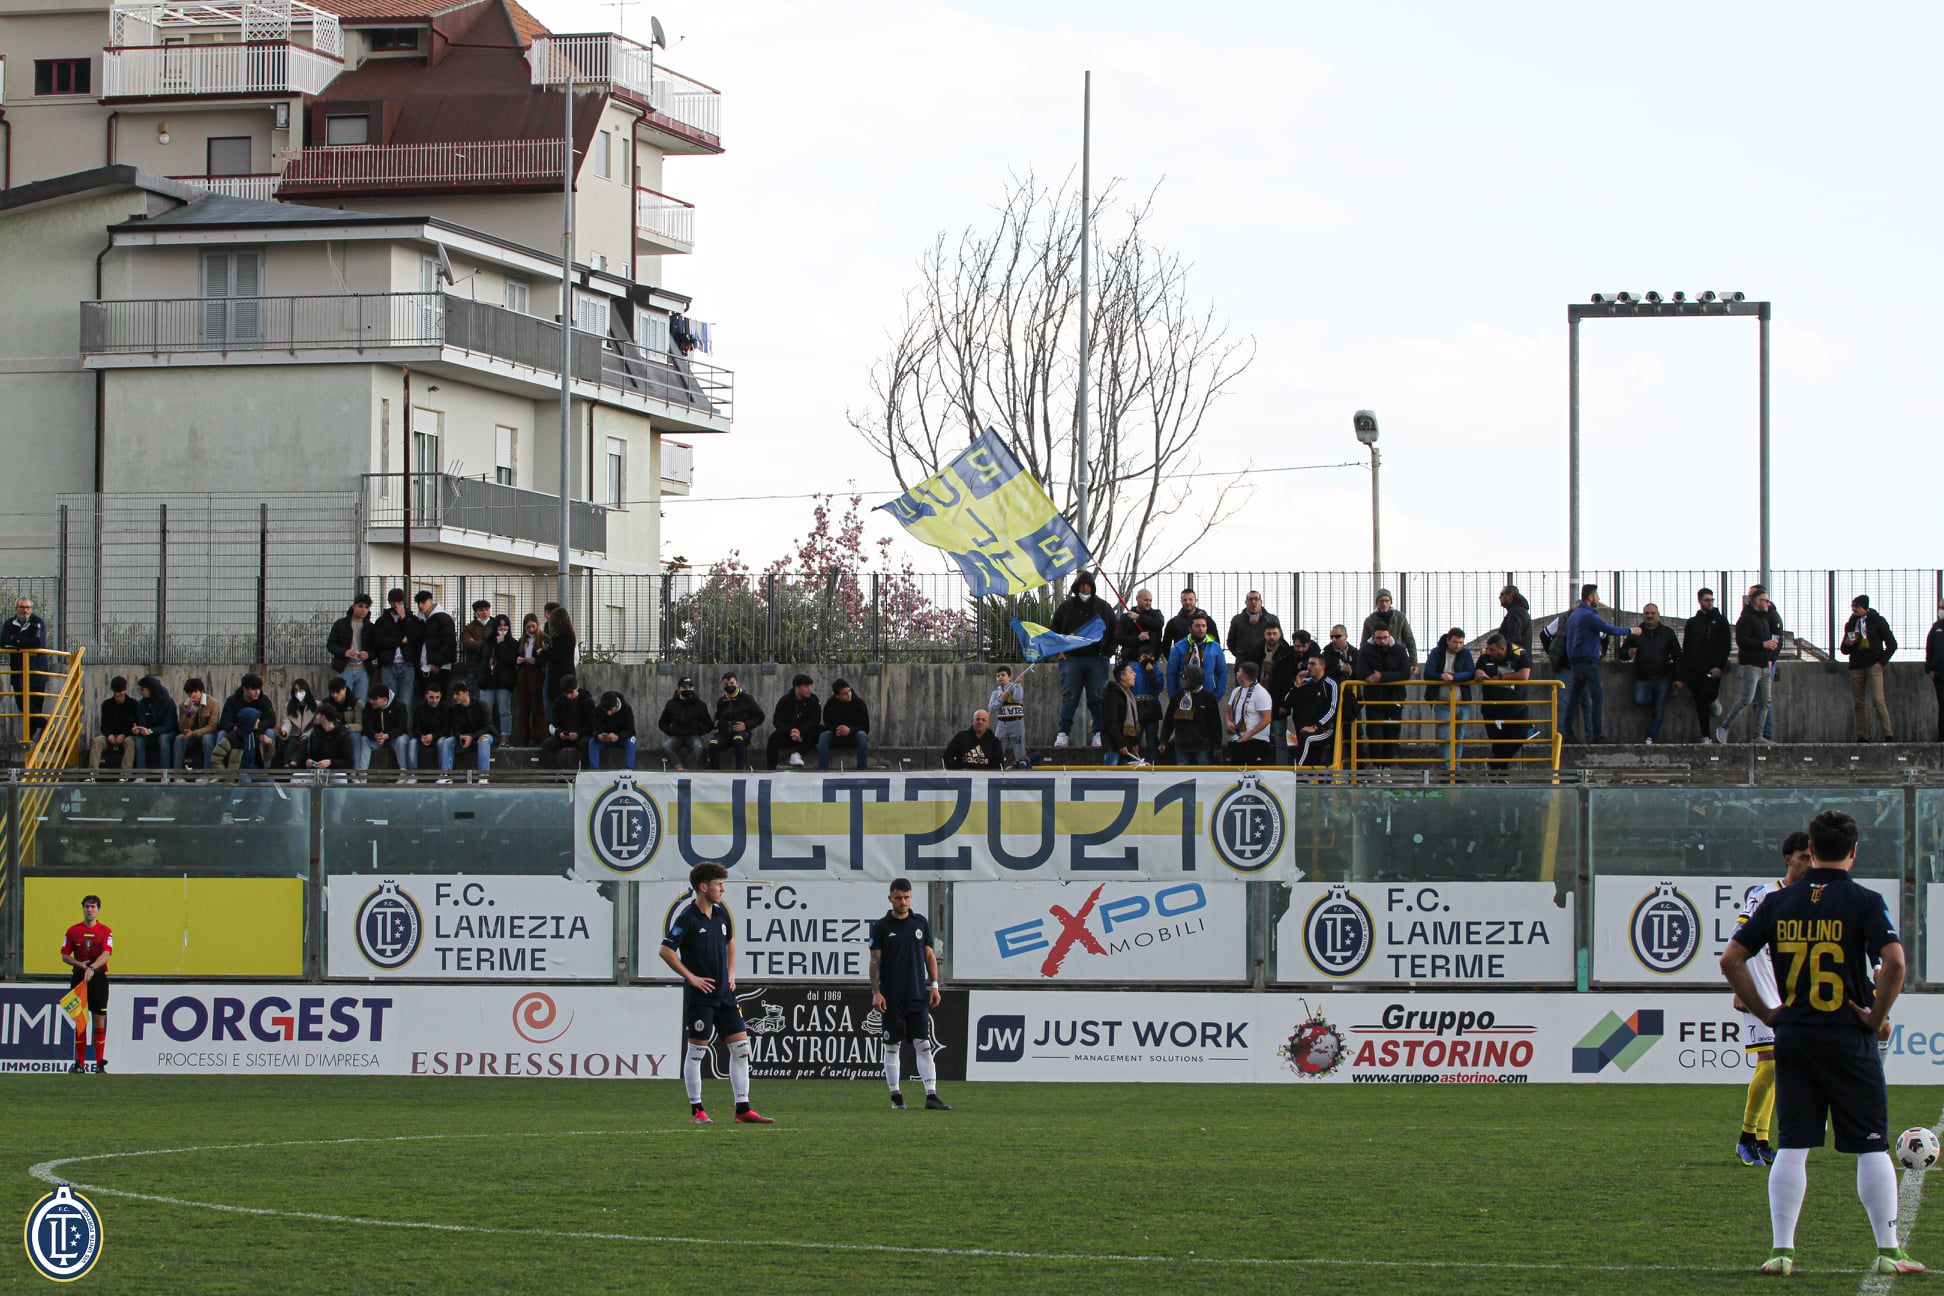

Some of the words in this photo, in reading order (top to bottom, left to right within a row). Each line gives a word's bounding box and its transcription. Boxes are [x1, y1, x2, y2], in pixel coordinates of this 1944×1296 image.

[677, 778, 1197, 872] ULT2021
[435, 883, 495, 907] F.C.
[746, 885, 808, 910] F.C.
[1387, 888, 1450, 912] F.C.
[435, 915, 590, 940] LAMEZIA
[746, 918, 876, 942] LAMEZI
[995, 882, 1207, 977] EXPO
[1109, 918, 1205, 955] MOBILI
[1387, 921, 1550, 945] LAMEZIA
[1777, 919, 1843, 942] BOLLINO
[434, 947, 547, 971] TERME
[745, 951, 860, 975] TERME
[1386, 954, 1505, 978] TERME
[1777, 942, 1845, 1012] 76
[807, 990, 821, 1001] dal
[824, 991, 842, 1001] 1969
[131, 995, 393, 1042] FORGEST
[793, 1004, 854, 1032] CASA
[1382, 1004, 1495, 1036] Gruppo
[978, 1027, 1022, 1051] JW
[1033, 1020, 1122, 1047] JUST
[1133, 1021, 1249, 1049] WORK
[157, 1053, 228, 1067] PROCESSI
[233, 1053, 240, 1067] E
[246, 1053, 300, 1067] SISTEMI
[305, 1053, 380, 1067] D'IMPRESA
[410, 1051, 668, 1077] ESPRESSIONY
[1074, 1054, 1143, 1062] MANAGEMENT
[1149, 1055, 1204, 1063] SOLUTIONS
[1352, 1039, 1534, 1067] ASTORINO
[796, 1068, 815, 1080] per
[1352, 1071, 1528, 1084] www.gruppoastorino.com
